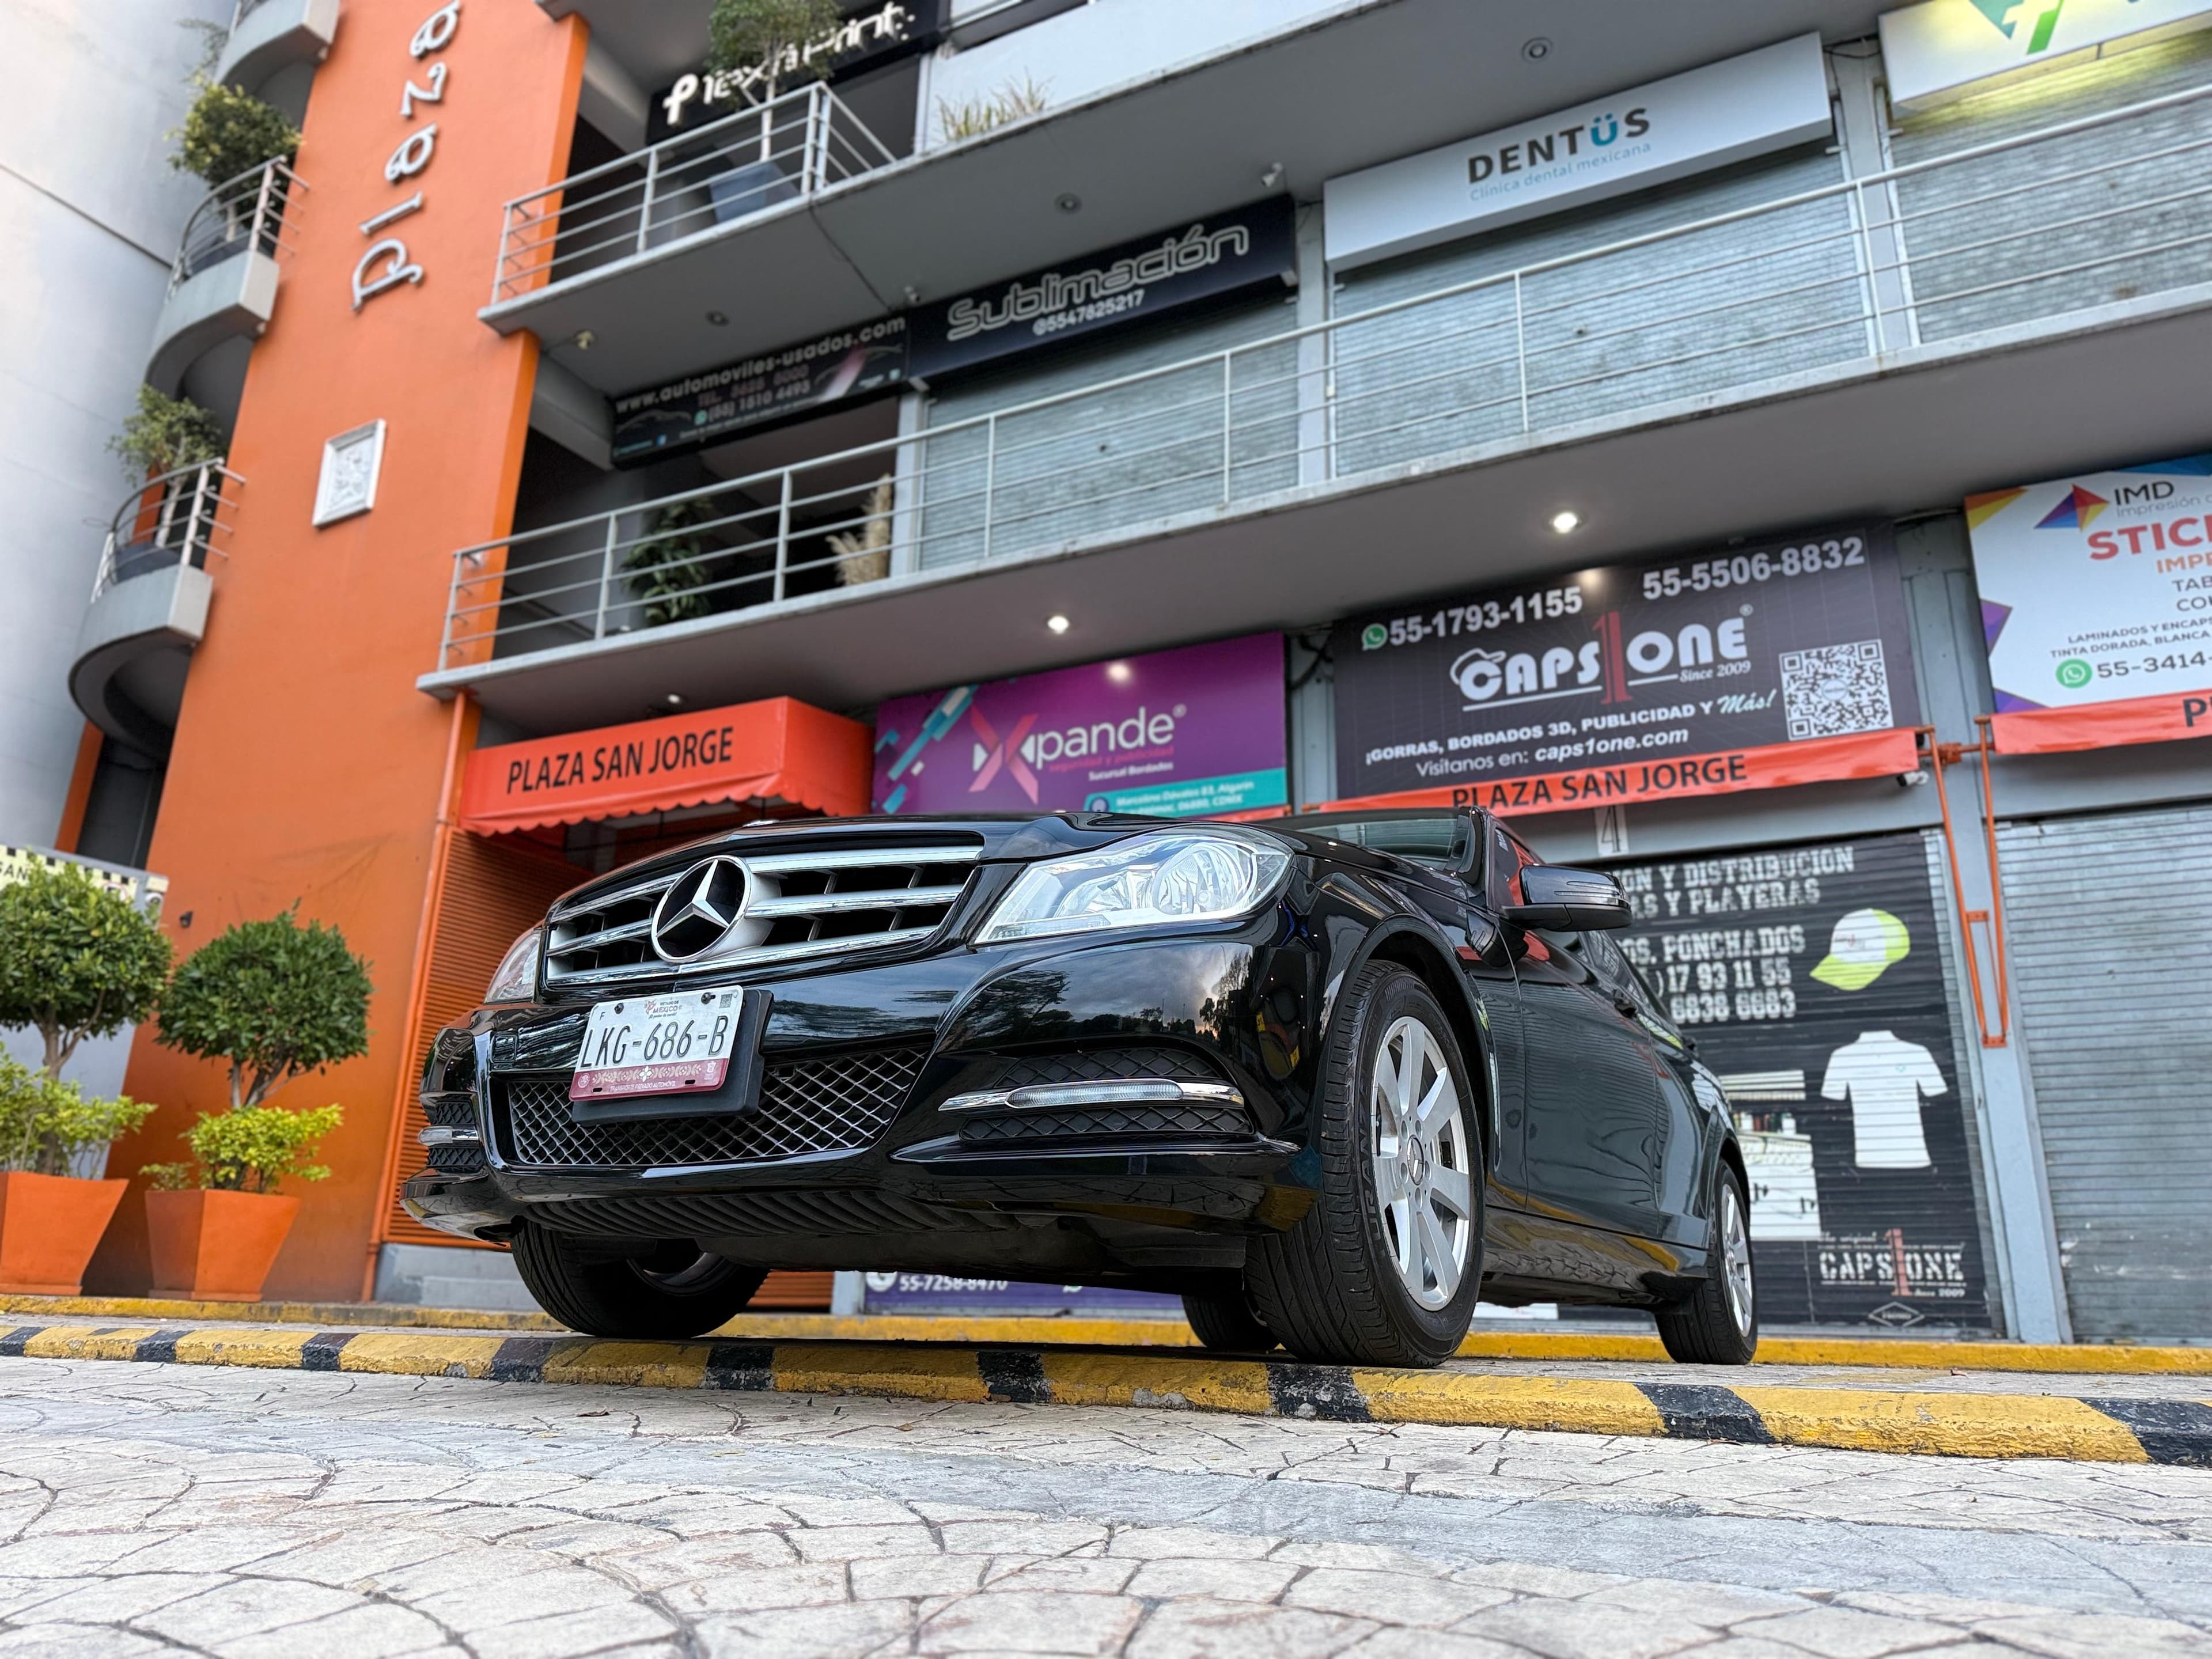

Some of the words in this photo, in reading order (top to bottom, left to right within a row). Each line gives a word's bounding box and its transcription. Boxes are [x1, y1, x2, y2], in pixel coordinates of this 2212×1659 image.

[351, 0, 460, 310] Plaza
[1468, 108, 1650, 184] DENTÜS
[1524, 163, 1572, 187] dental
[1576, 142, 1652, 171] mexicana
[947, 225, 1249, 341] Sublimación
[616, 316, 906, 414] www.automoviles-usados.com
[2113, 481, 2175, 506] IMD
[2116, 496, 2200, 517] Impresión
[2087, 513, 2212, 560] STIC
[1643, 536, 1865, 600] 55-5506-8832
[1389, 586, 1583, 646] 55-1793-1155
[2176, 595, 2212, 612] CO
[2050, 646, 2088, 658] TINTA
[2154, 630, 2210, 645] BLANCA
[2067, 625, 2148, 644] LAMINADOS
[2150, 624, 2159, 632] Y
[1679, 668, 1714, 683] Since
[1716, 661, 1752, 676] 2009
[1448, 725, 1544, 751] BORDADOS
[1548, 721, 1577, 737] 3D,
[1581, 703, 1696, 732] PUBLICIDAD
[1699, 700, 1714, 715] Y
[1717, 688, 1778, 714] Más!
[507, 752, 584, 794] PLAZA
[591, 741, 644, 782] SAN
[649, 726, 734, 775] JORGE
[1498, 751, 1529, 767] en:
[1534, 728, 1689, 763] caps1one.com
[1452, 779, 1552, 807] PLAZA
[1561, 768, 1628, 801] SAN
[1637, 754, 1748, 793] JORGE
[1658, 865, 1676, 889] Y
[1683, 846, 1854, 888] DISTRIBUCION
[1663, 891, 1681, 916] Y
[1687, 878, 1821, 914] PLAYERAS
[1661, 924, 1806, 964] PONCHADOS
[1666, 964, 1690, 993] 17
[1696, 961, 1728, 991] 93
[1733, 959, 1755, 988] 11
[1760, 956, 1792, 987] 55
[599, 1012, 606, 1021] F
[580, 1016, 729, 1068] LKG-686-B
[1938, 1288, 1965, 1297] 2009
